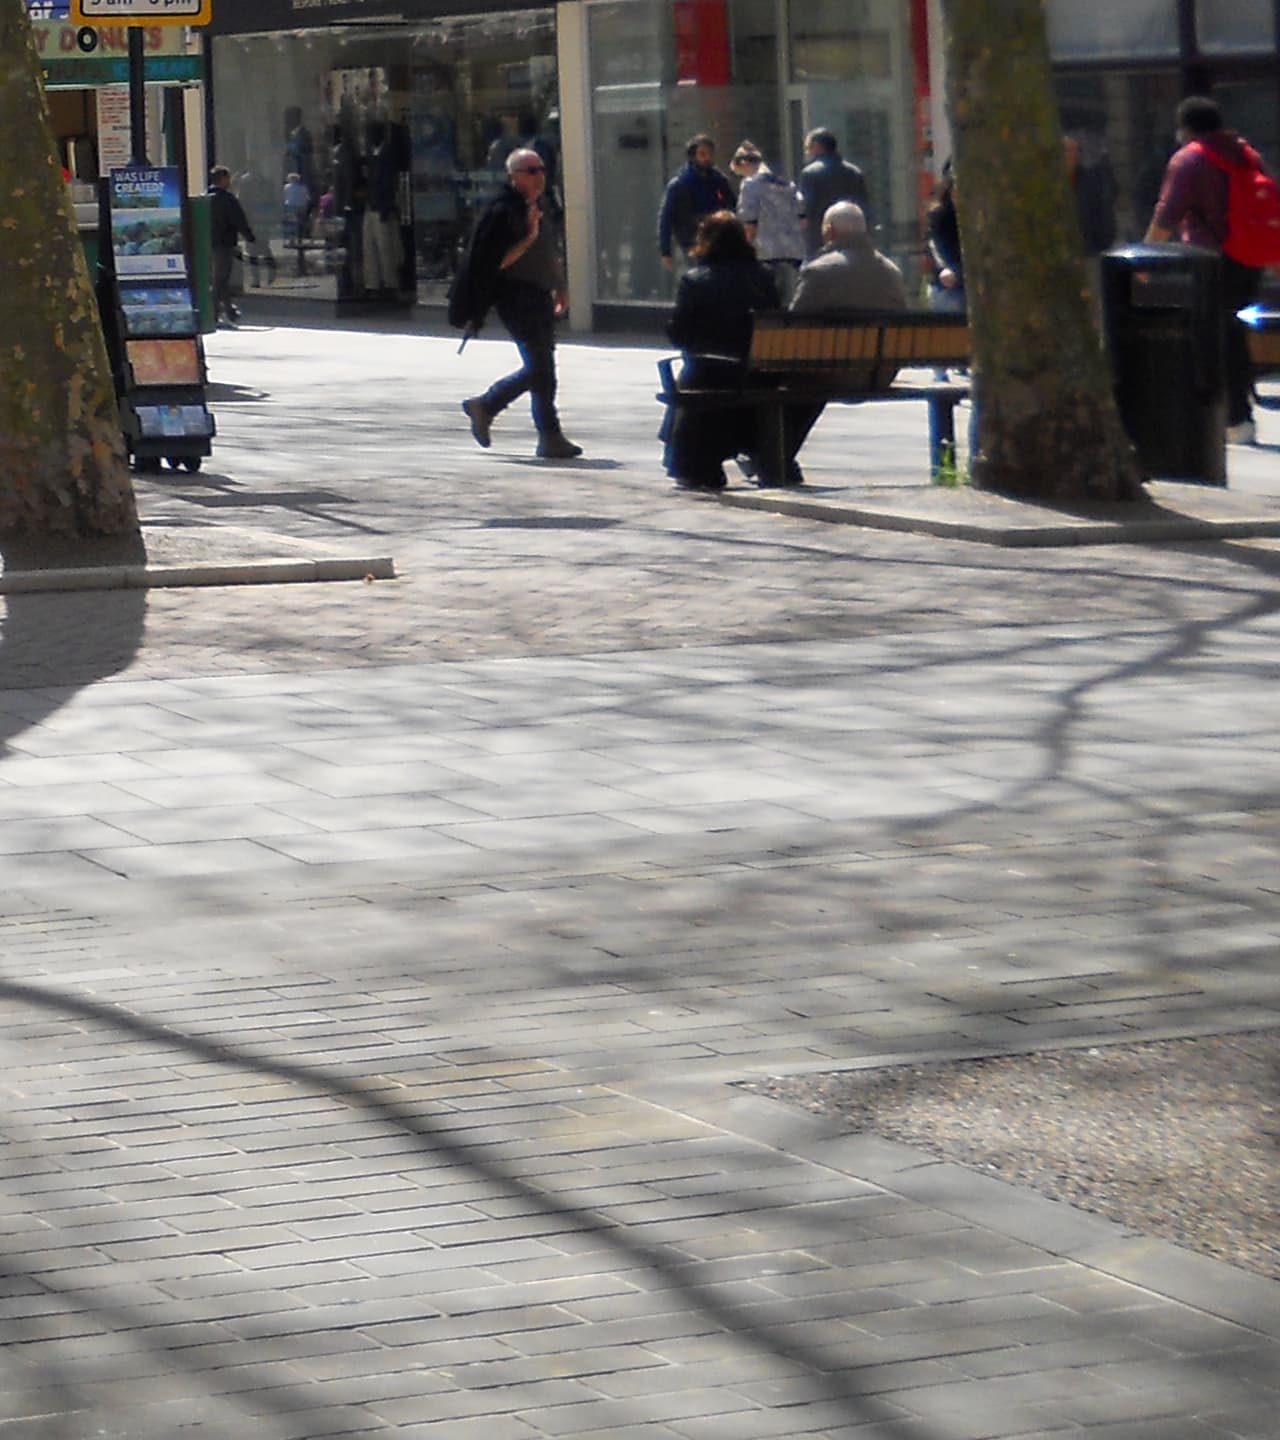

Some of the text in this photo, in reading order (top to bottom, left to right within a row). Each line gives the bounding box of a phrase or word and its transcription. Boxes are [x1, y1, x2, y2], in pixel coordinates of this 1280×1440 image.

[59, 25, 162, 52] DONUS
[114, 171, 160, 182] WAS LIFE
[114, 182, 165, 193] CREATED?
